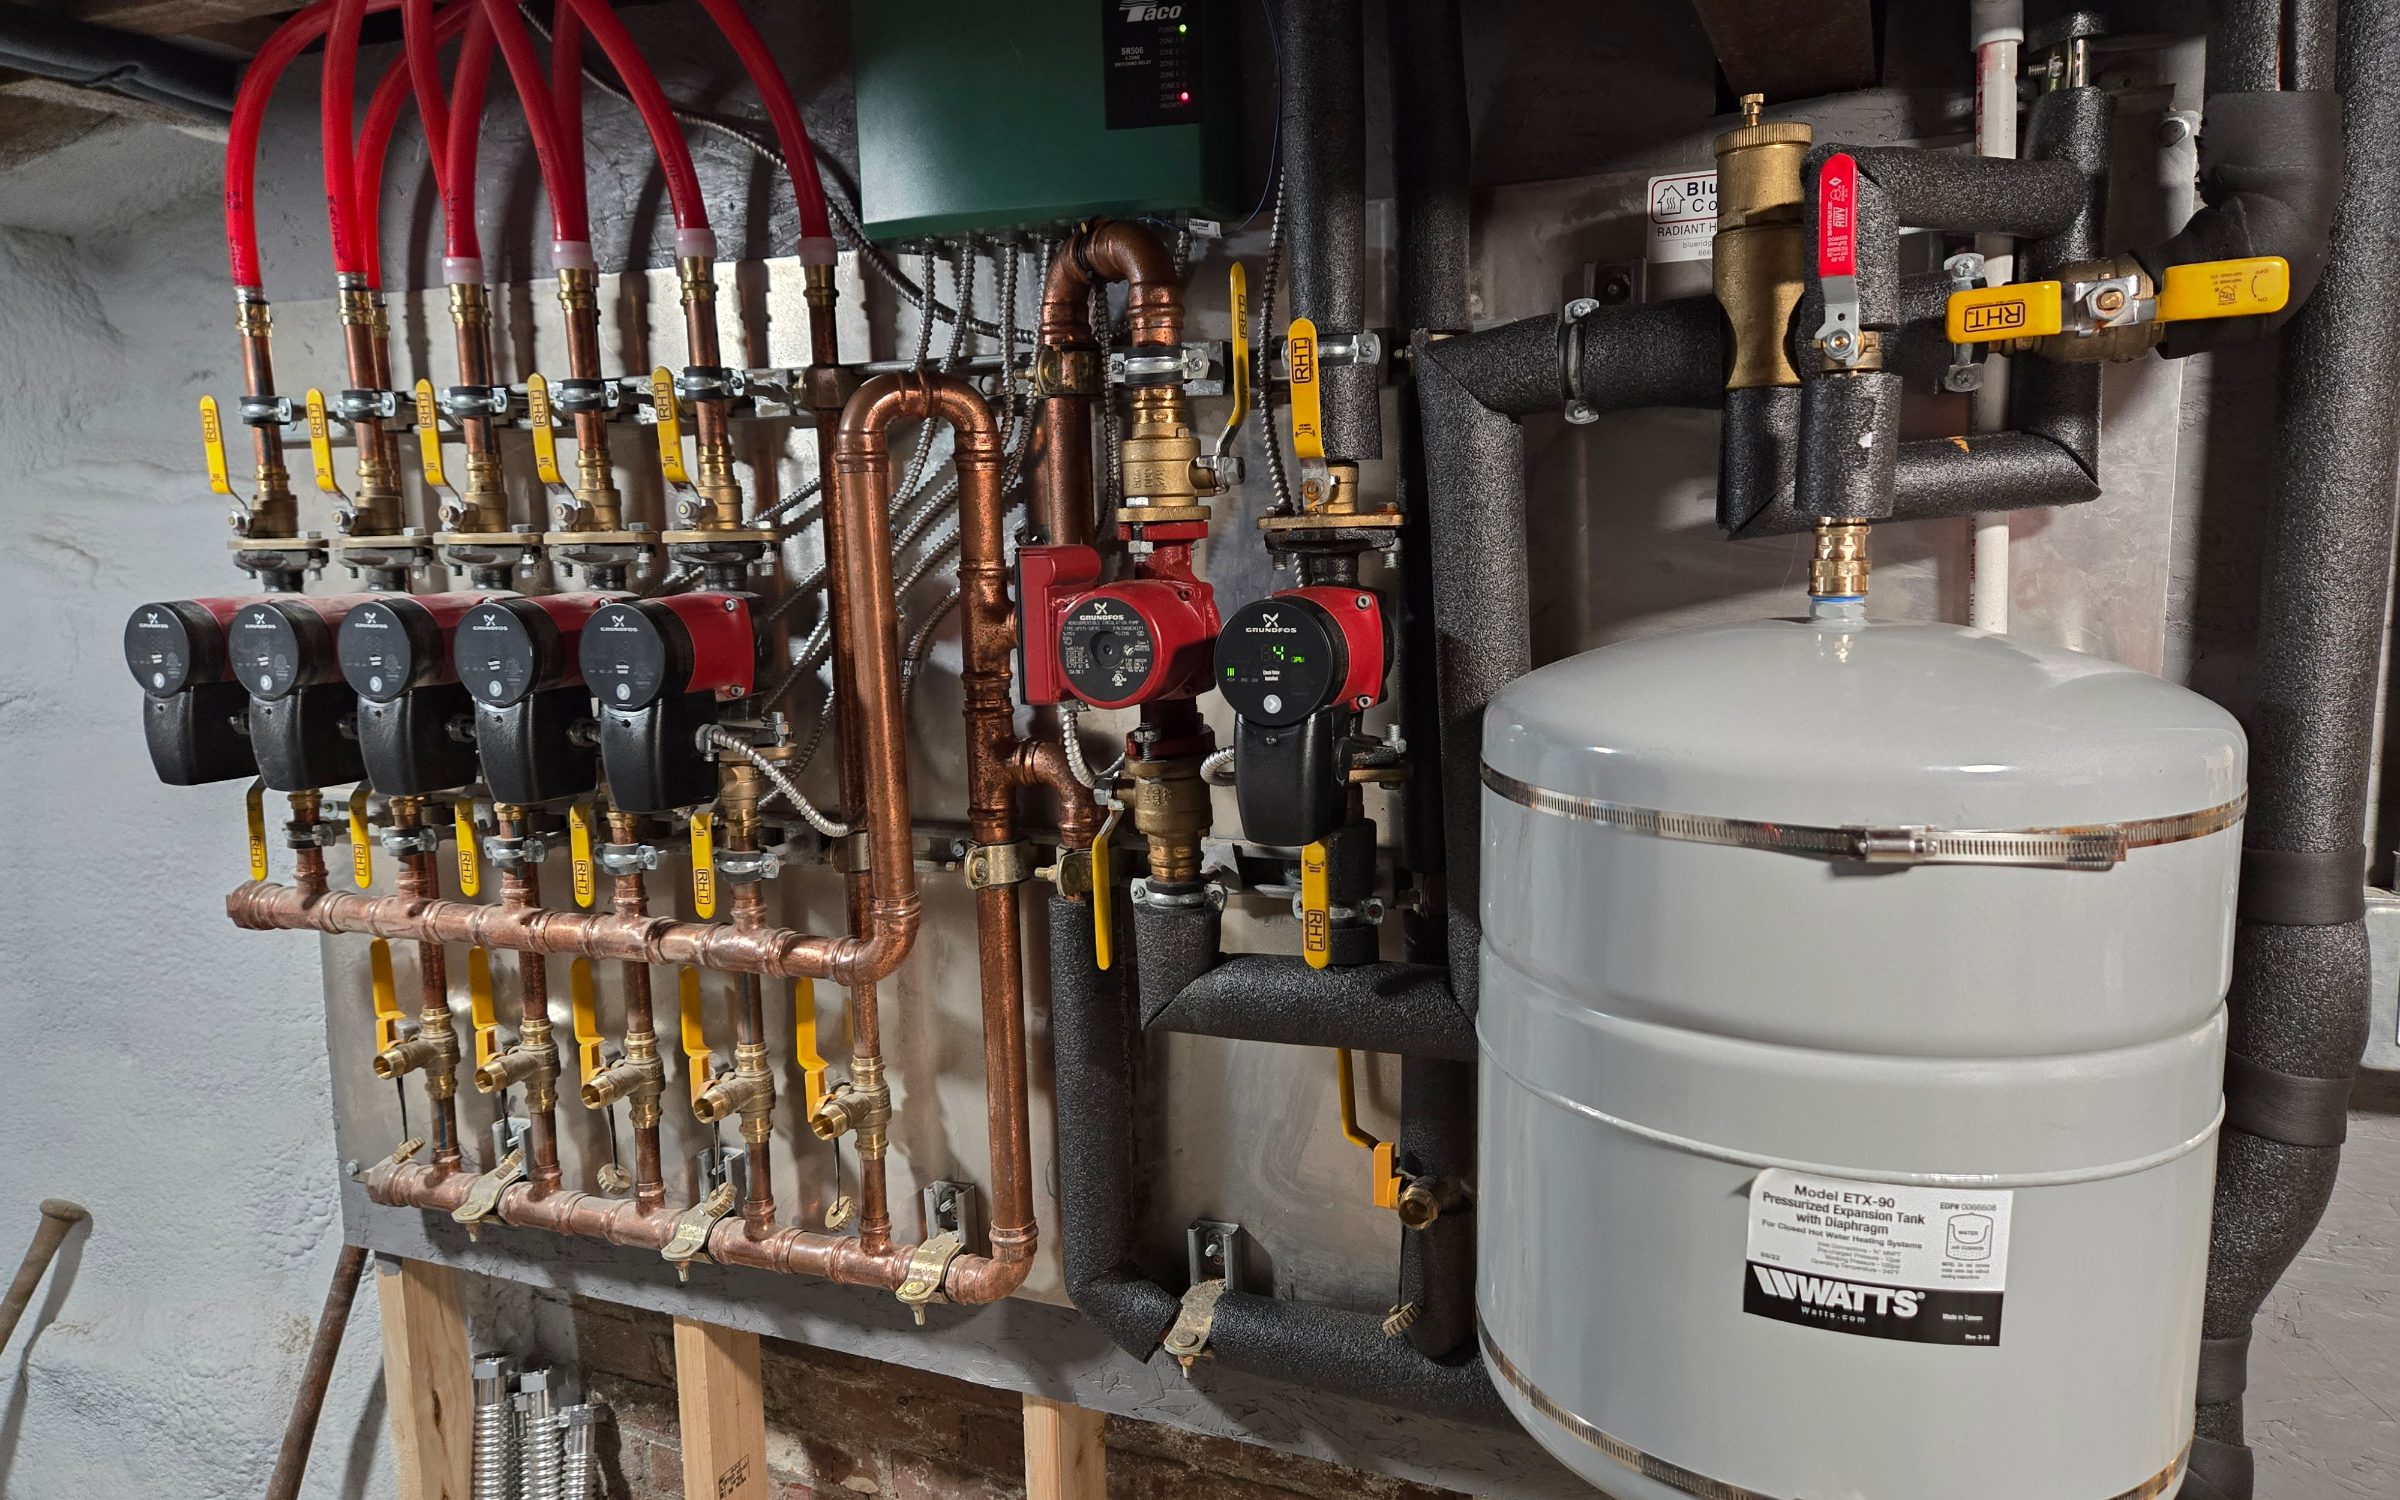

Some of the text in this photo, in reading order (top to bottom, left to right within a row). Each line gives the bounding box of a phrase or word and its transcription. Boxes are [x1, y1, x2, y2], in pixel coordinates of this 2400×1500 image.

[1119, 4, 1183, 22] Taco
[1657, 223, 1706, 237] RADIANT
[1272, 645, 1285, 661] 4
[1794, 1185, 1895, 1208] Model ETX-90
[1763, 1192, 1926, 1225] Pressurized Expansion Tank
[1762, 1219, 1922, 1249] For Closed Hot Water Heating Systems
[1796, 1213, 1889, 1235] with Diaphragm
[1794, 1274, 1919, 1318] WATTS
[1801, 1306, 1866, 1323] Watts.com
